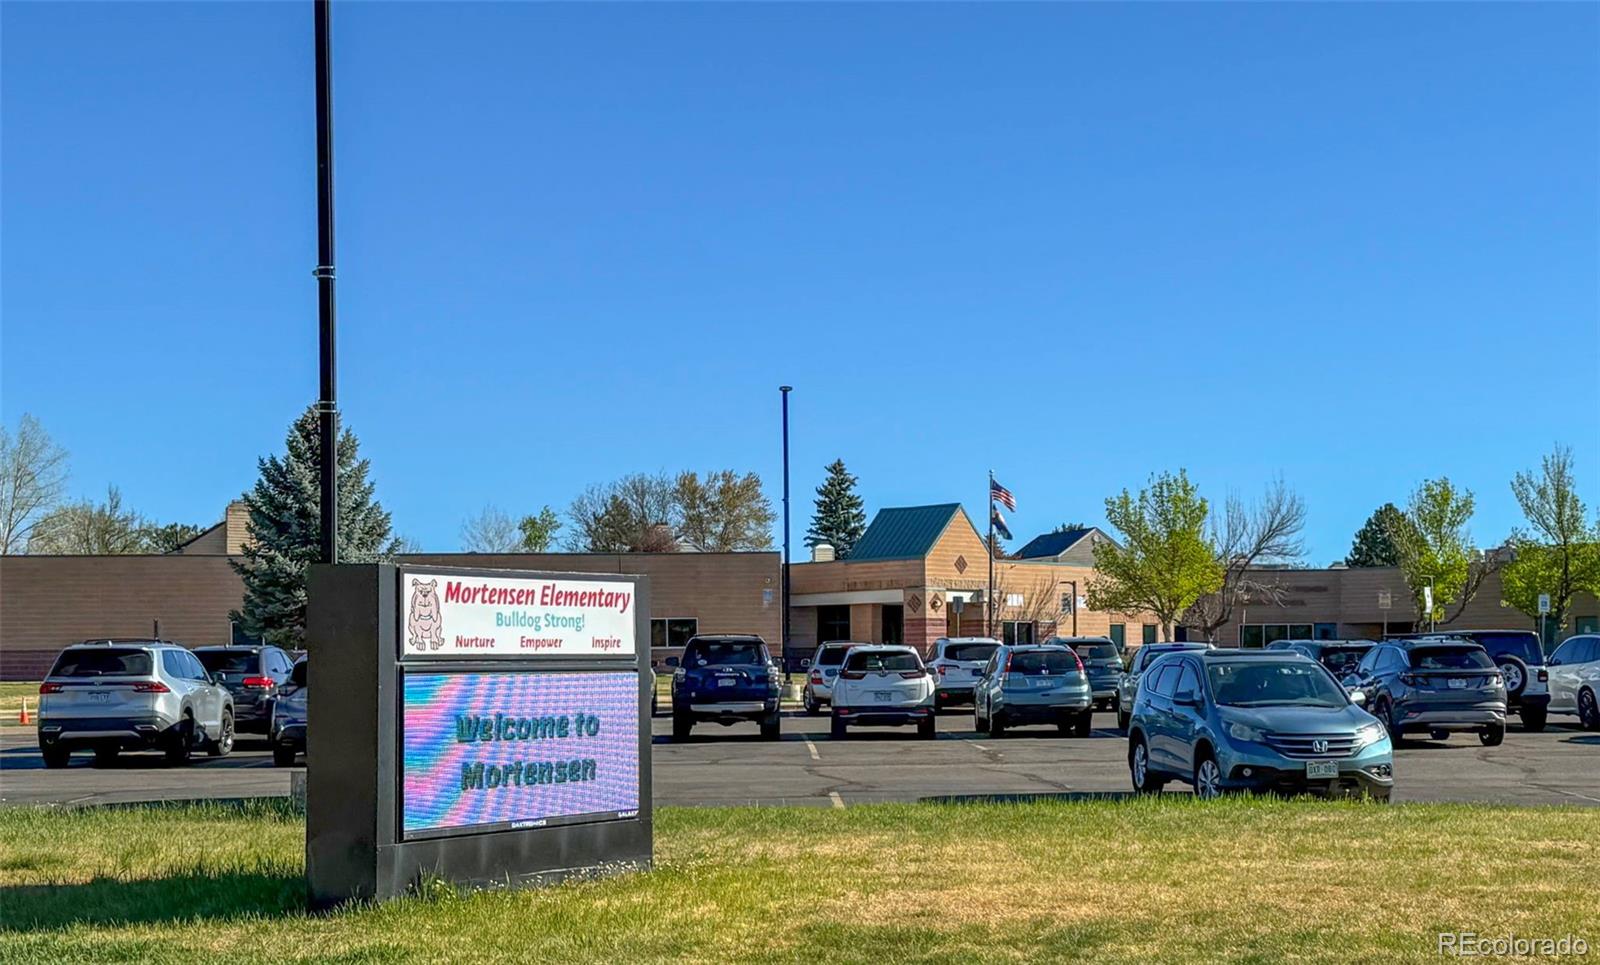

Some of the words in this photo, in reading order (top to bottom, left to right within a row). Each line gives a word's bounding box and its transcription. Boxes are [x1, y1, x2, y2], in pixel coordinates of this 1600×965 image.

[444, 581, 535, 606] Mortensen
[540, 583, 631, 614] Elementary
[496, 610, 542, 632] Bulldog
[544, 612, 585, 632] Strong!
[455, 635, 496, 649] Nurture
[520, 635, 564, 652] Empower
[592, 635, 622, 652] Inspire
[456, 711, 570, 743] Welcome
[574, 712, 600, 737] to
[461, 758, 597, 791] Mortensen
